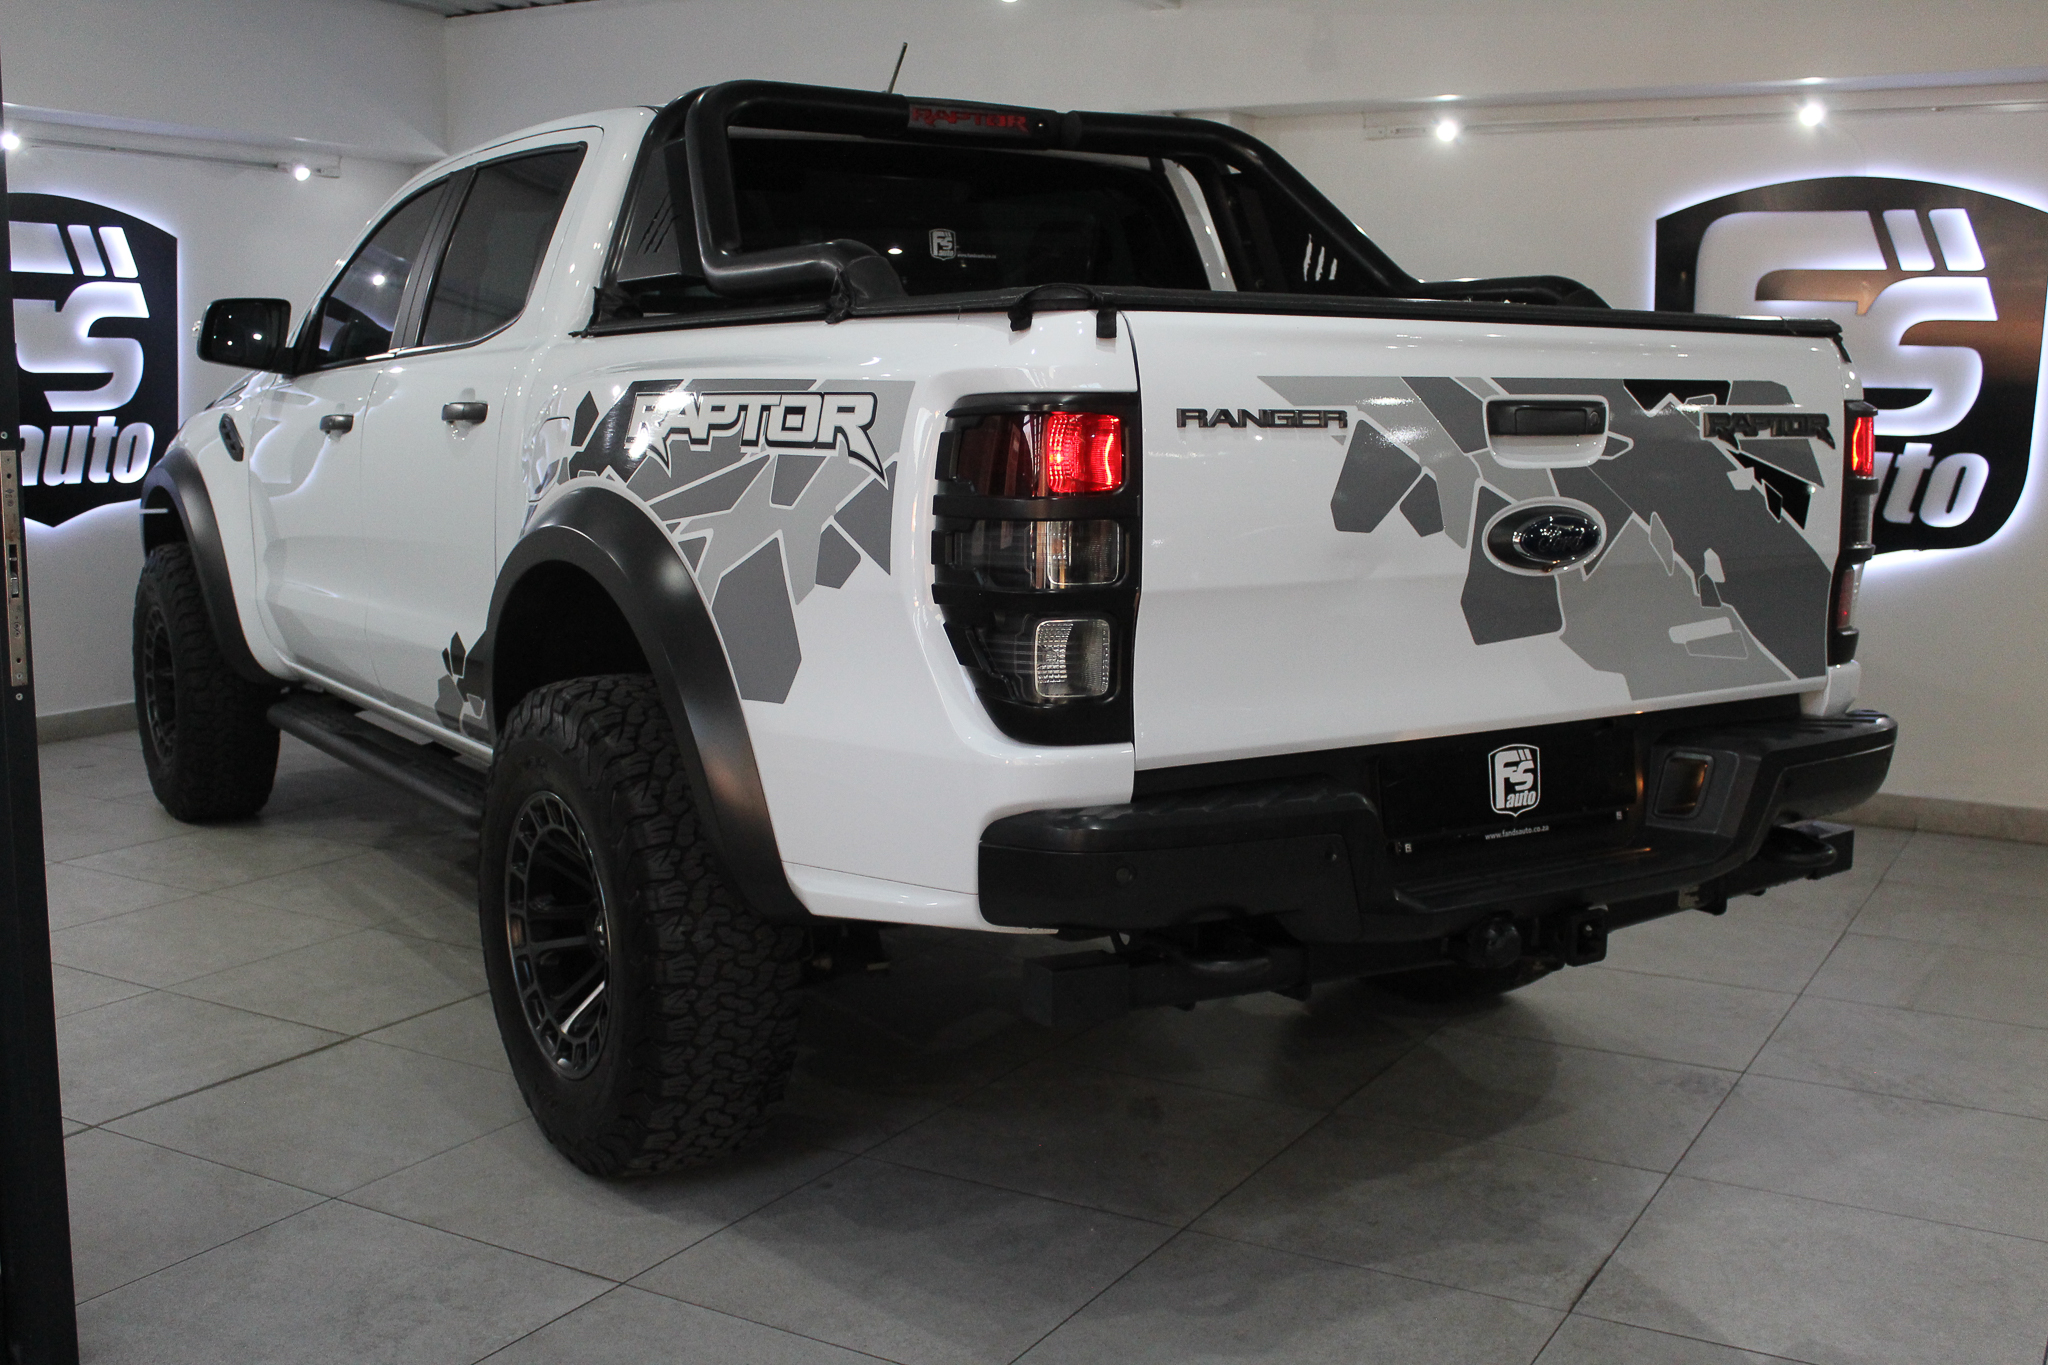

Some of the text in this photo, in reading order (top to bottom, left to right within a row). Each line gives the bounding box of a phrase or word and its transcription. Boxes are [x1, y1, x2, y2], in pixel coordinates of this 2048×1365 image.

[912, 107, 1029, 133] RAPTOR
[932, 231, 952, 255] FS
[1176, 408, 1348, 429] RANGER
[1703, 412, 1836, 450] RAPTOR
[624, 391, 889, 490] RAPTOR
[1870, 442, 1990, 528] to
[1494, 748, 1535, 809] FS
[1506, 790, 1537, 808] auto
[1484, 825, 1549, 839] www.fandsauto.co.za
